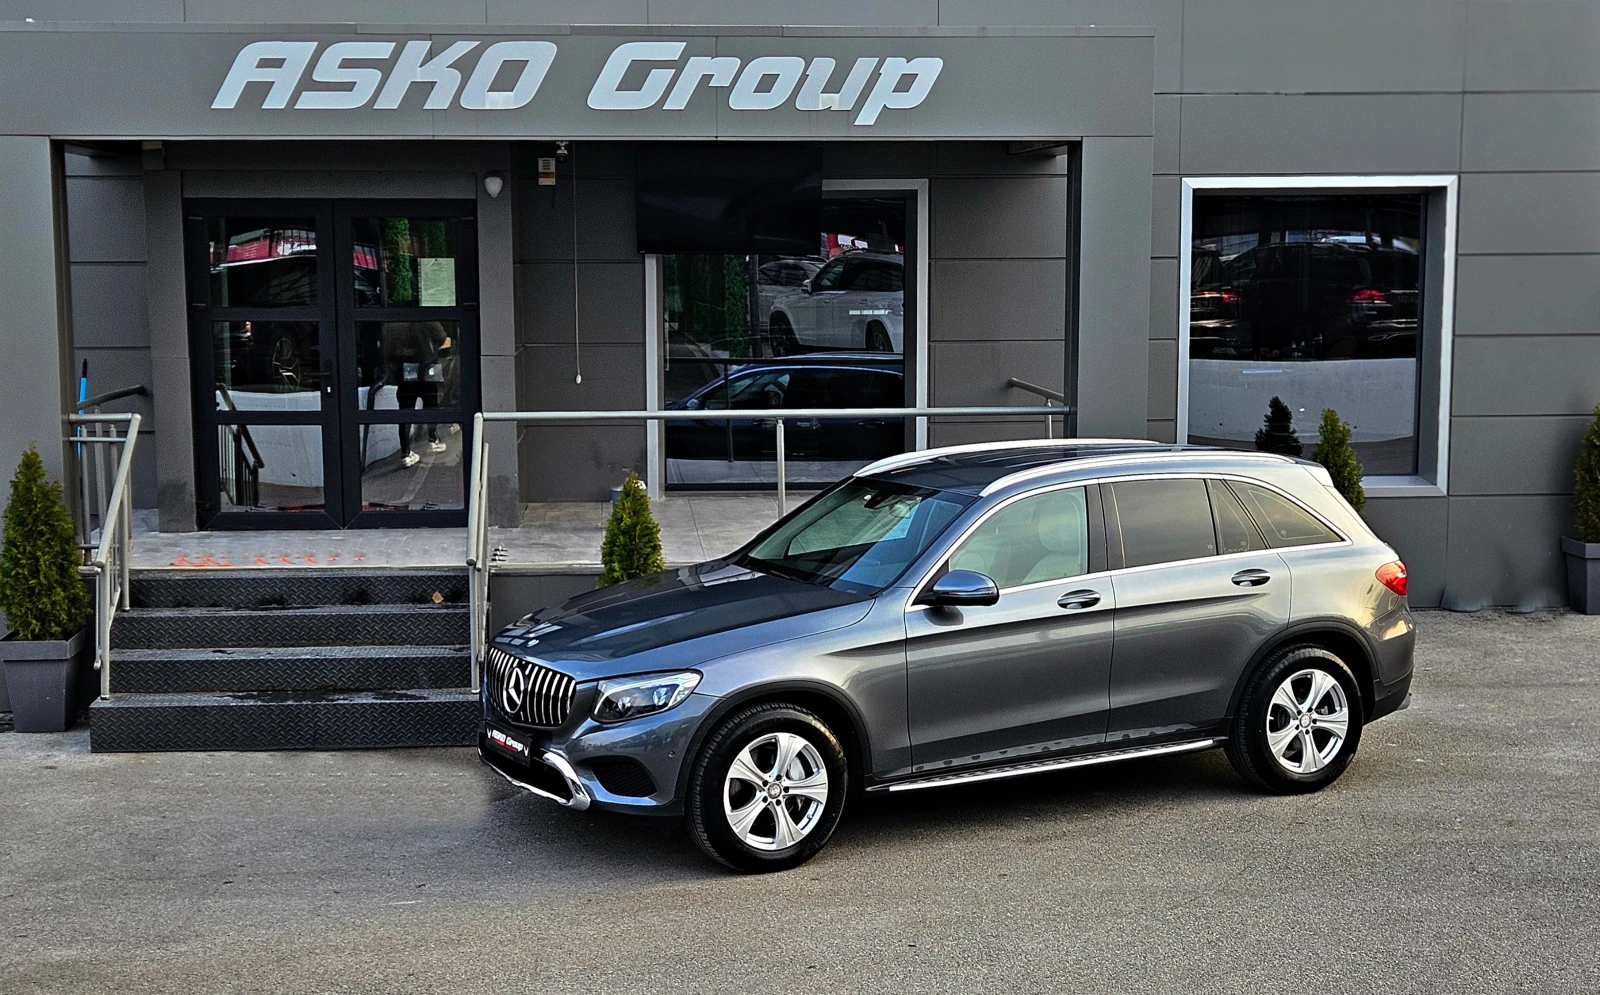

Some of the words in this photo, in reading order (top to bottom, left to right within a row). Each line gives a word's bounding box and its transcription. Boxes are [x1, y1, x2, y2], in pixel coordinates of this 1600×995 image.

[211, 41, 558, 110] ASKO
[587, 41, 944, 126] Group
[506, 737, 523, 751] Group
